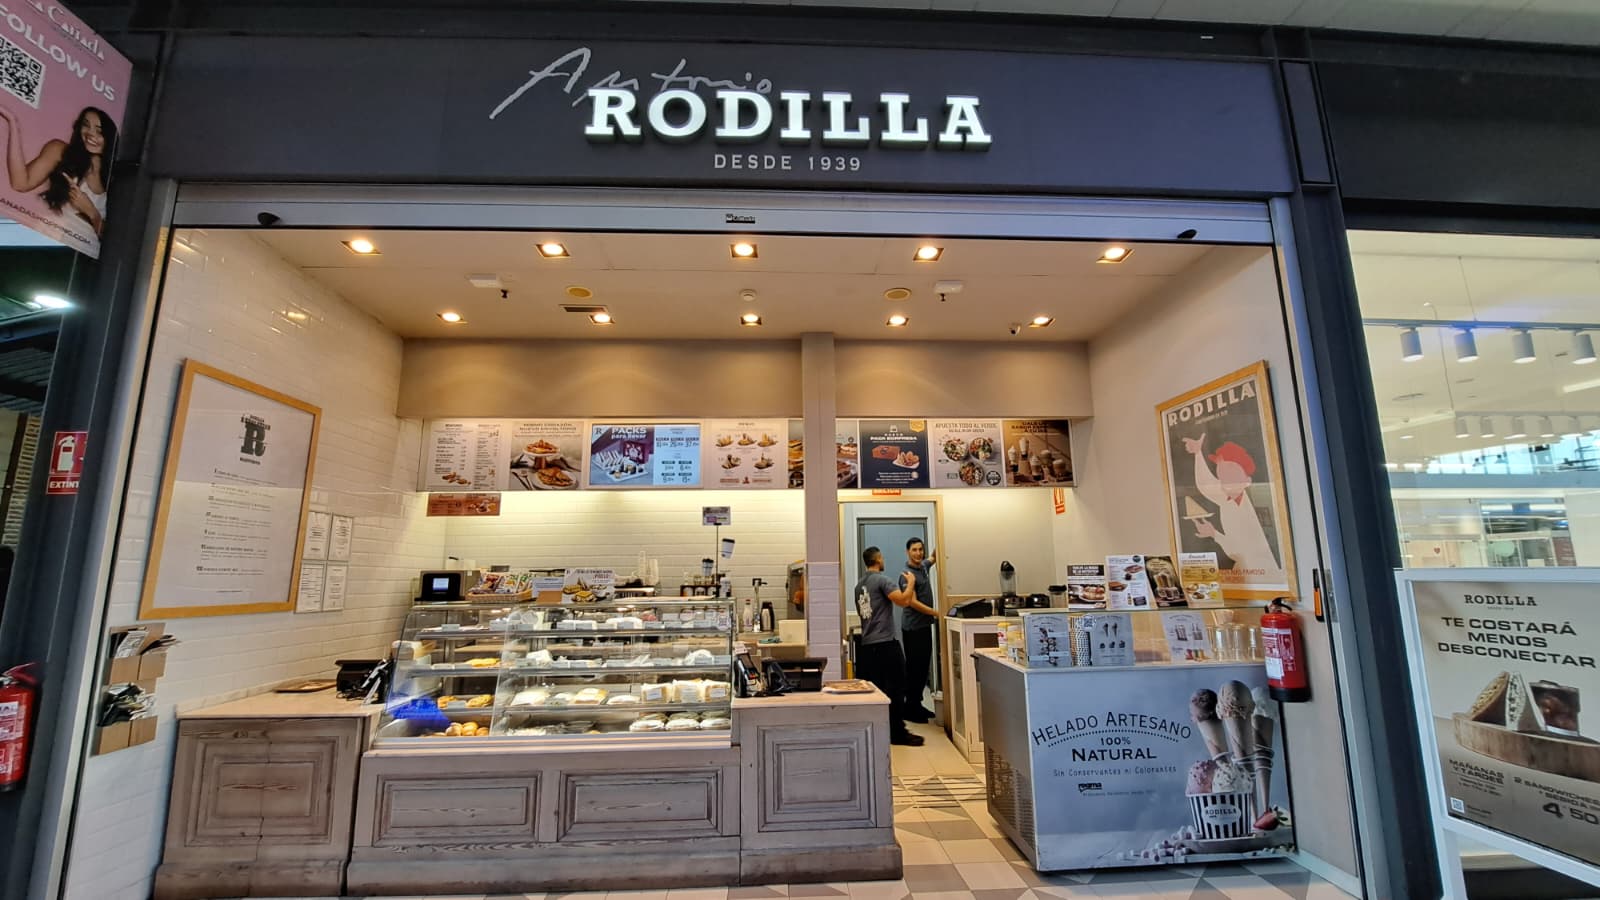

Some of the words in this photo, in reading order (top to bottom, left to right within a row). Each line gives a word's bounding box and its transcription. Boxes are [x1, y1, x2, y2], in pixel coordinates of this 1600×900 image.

[91, 75, 116, 101] US
[586, 88, 992, 143] RODILLA
[713, 155, 793, 170] DESDE
[808, 156, 862, 172] 1939
[1167, 382, 1256, 427] RODILLA
[611, 426, 647, 434] PACKS
[1464, 594, 1537, 606] RODILLA
[1441, 617, 1465, 628] TE
[1469, 618, 1577, 636] COSTARÁ
[1467, 632, 1548, 648] MENOS
[1438, 642, 1596, 669] DESCONECTAR
[1032, 715, 1098, 746] HELADO
[1105, 711, 1191, 739] ARTESANO
[1100, 736, 1131, 746] 100%
[1072, 747, 1157, 762] NATURAL
[1053, 768, 1065, 777] Sin
[1068, 767, 1121, 777] Conservantes
[1135, 765, 1177, 775] Colorantes
[1449, 759, 1505, 779] MAÑANAS
